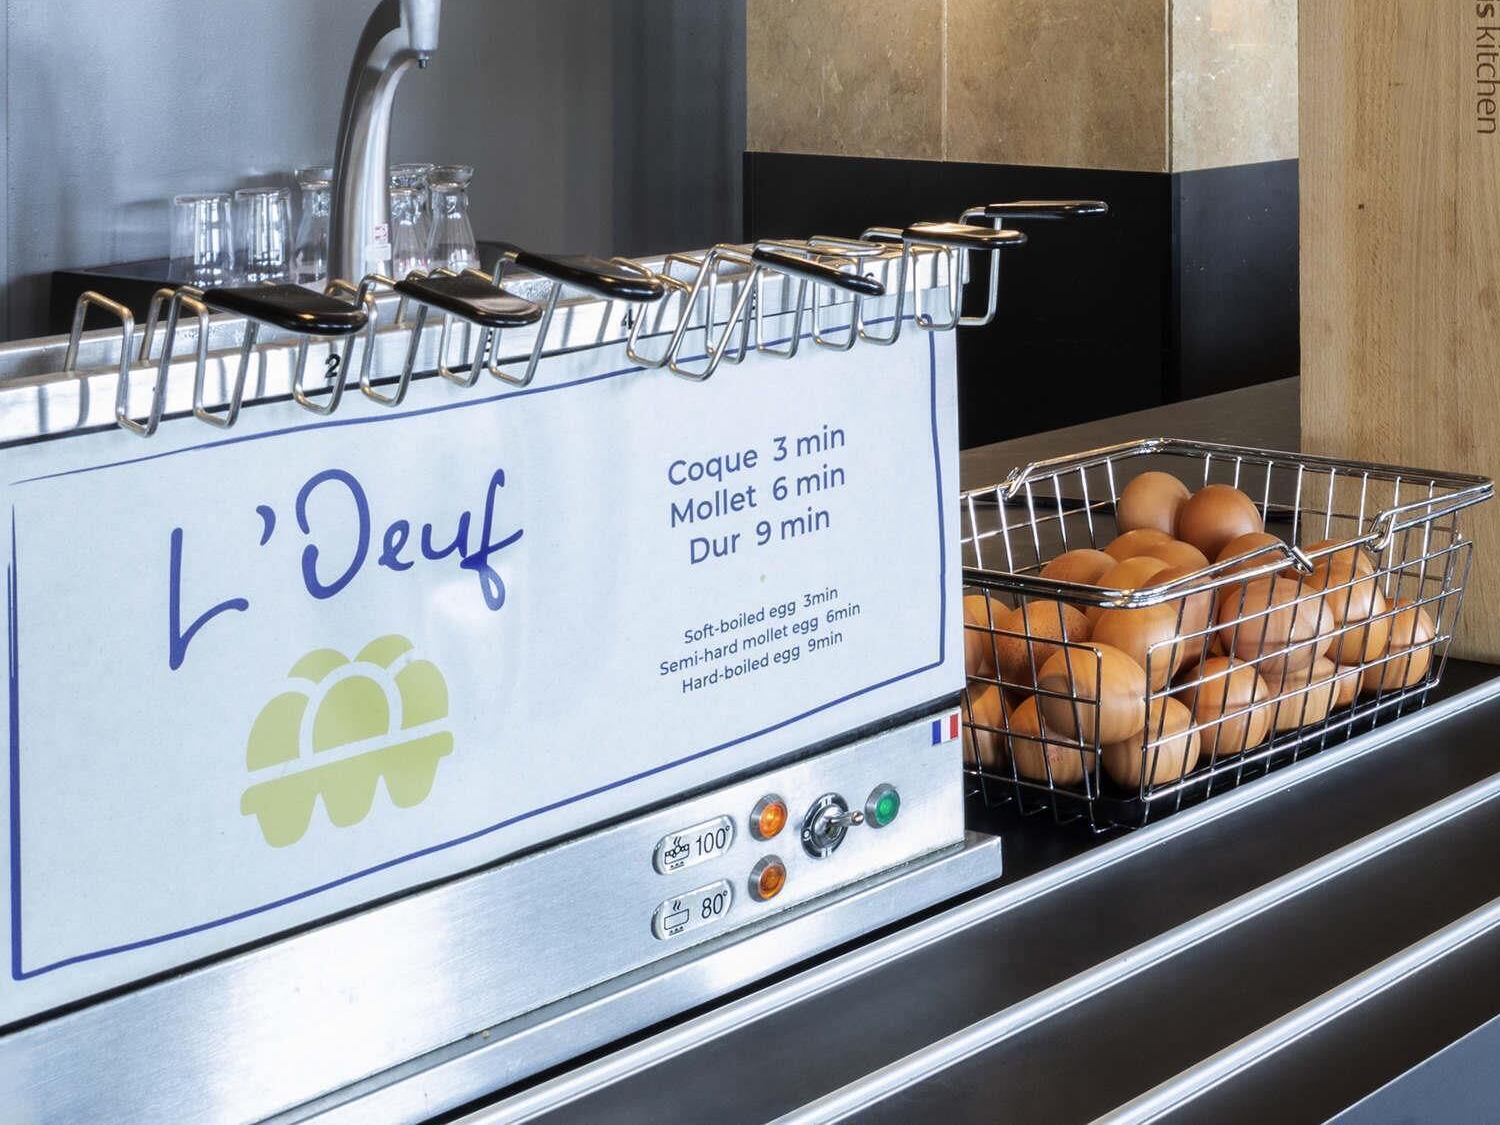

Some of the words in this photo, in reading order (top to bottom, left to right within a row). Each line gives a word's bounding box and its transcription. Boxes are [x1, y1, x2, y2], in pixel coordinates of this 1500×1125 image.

[324, 354, 341, 378] 2
[667, 448, 758, 486] Coque
[773, 436, 788, 462] 3
[797, 424, 846, 457] min
[670, 485, 758, 528] Mollet
[772, 476, 788, 501] 6
[797, 463, 846, 496] min
[690, 532, 741, 565] Dur
[756, 520, 772, 546] 9
[780, 506, 830, 540] min
[659, 639, 739, 676] Semi-hard
[742, 624, 789, 651] mollet
[792, 616, 819, 635] egg
[826, 603, 861, 624] 6min
[684, 607, 766, 644] Soft-boiled
[769, 600, 797, 618] egg
[803, 587, 839, 607] 3min
[682, 653, 770, 693] Hard-boiled
[773, 645, 801, 664] egg
[808, 630, 843, 653] 9min
[695, 825, 731, 856] 100°
[701, 889, 728, 919] 80°
